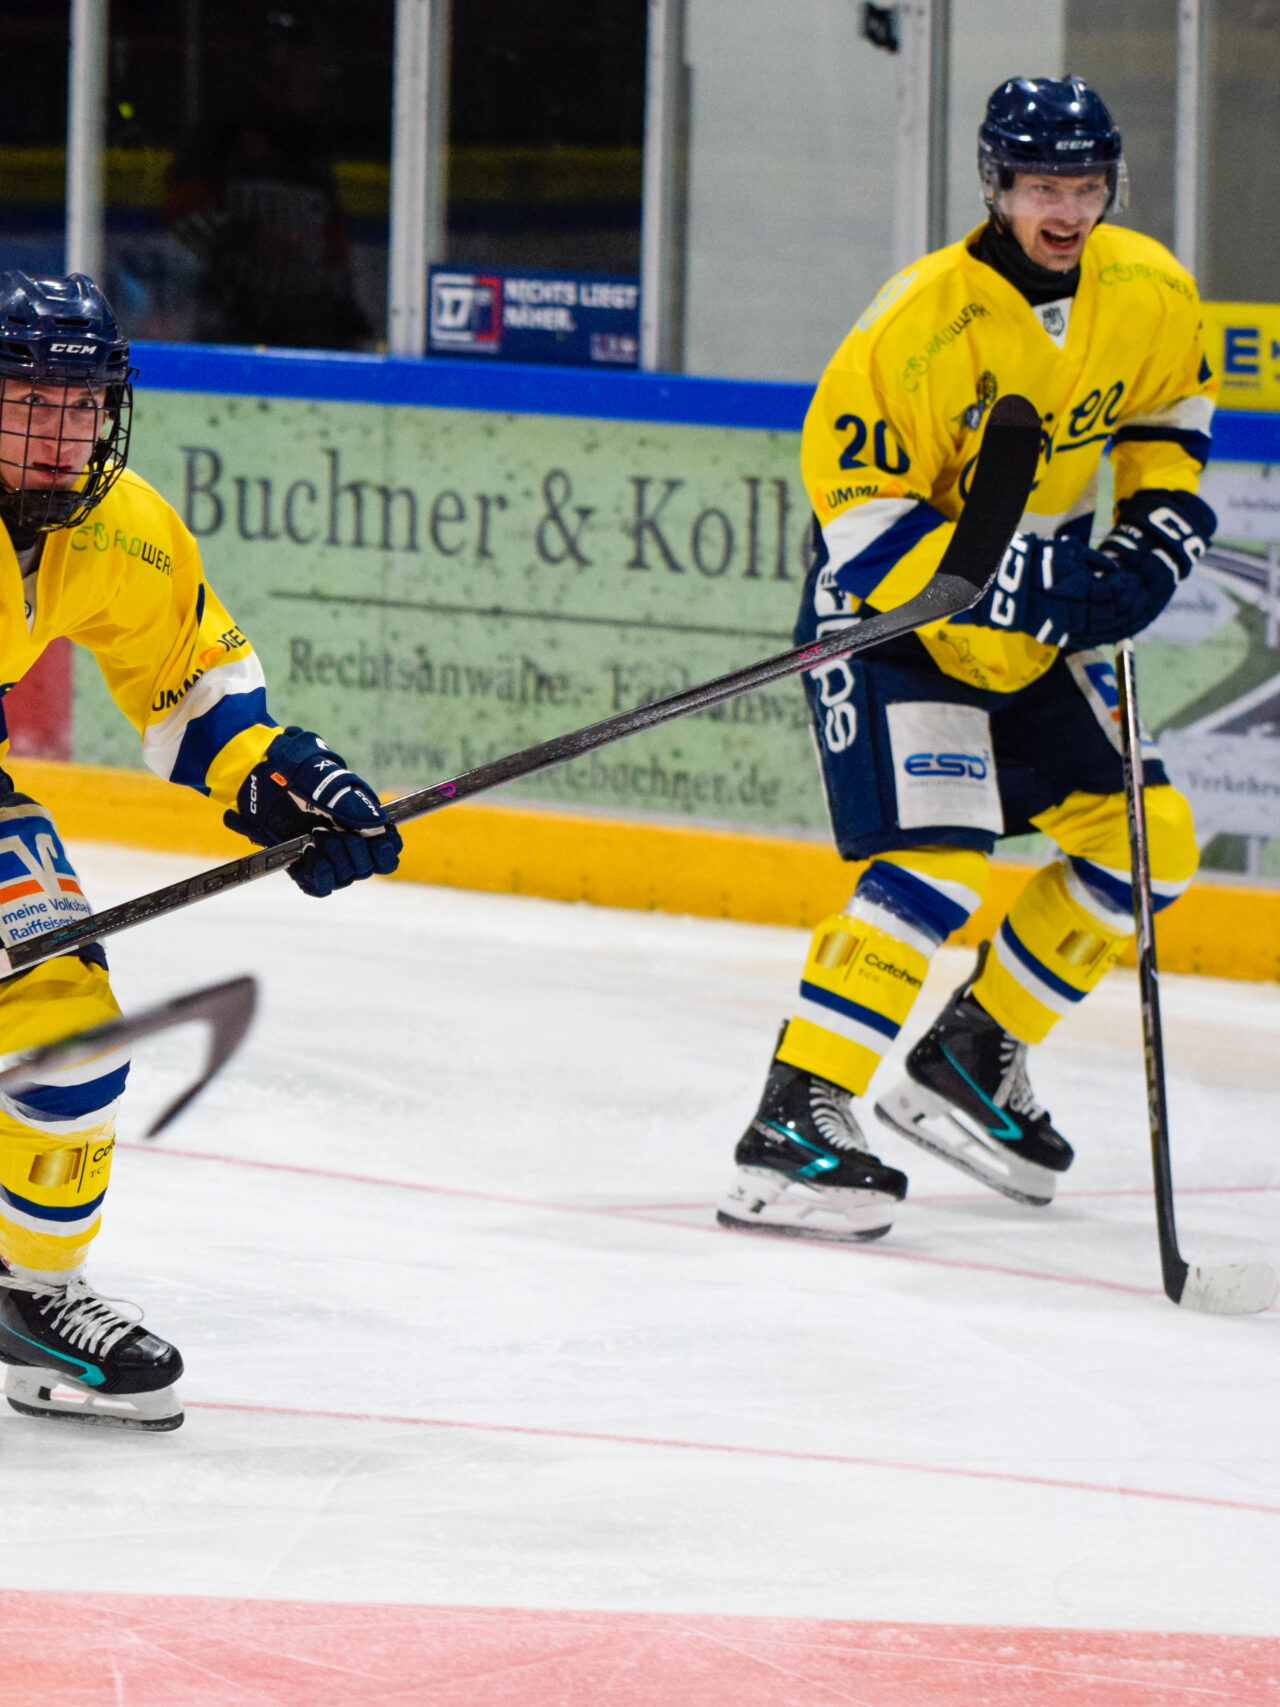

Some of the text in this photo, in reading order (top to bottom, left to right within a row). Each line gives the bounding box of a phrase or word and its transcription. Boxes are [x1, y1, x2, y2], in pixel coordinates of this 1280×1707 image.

[1055, 140, 1095, 151] CCM
[503, 278, 639, 310] NICHTS LIEGT
[49, 343, 98, 356] CCM
[834, 413, 910, 475] 20
[181, 446, 509, 562] Buchner
[534, 468, 592, 568] &
[1148, 506, 1207, 565] CC
[904, 752, 987, 780] ESD
[249, 774, 258, 816] CCM
[1, 902, 48, 925] meine
